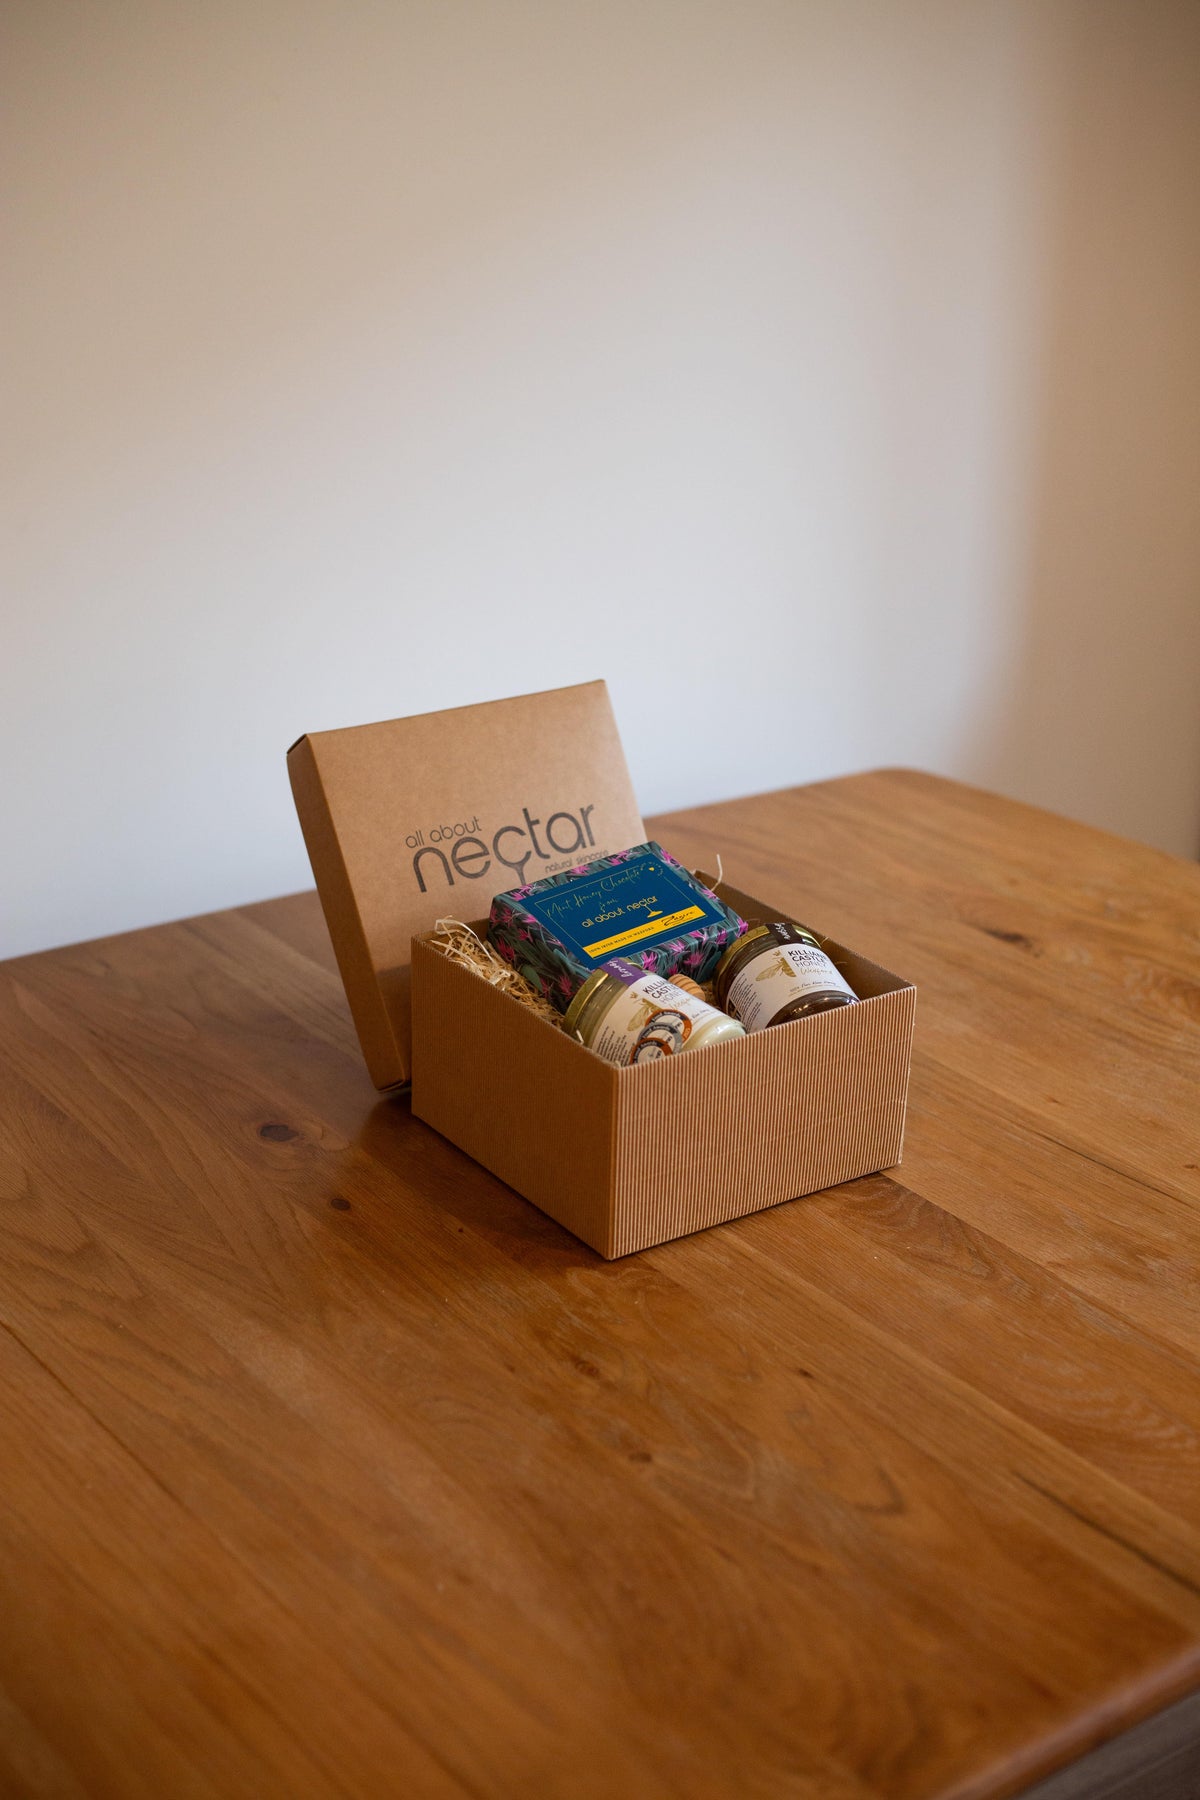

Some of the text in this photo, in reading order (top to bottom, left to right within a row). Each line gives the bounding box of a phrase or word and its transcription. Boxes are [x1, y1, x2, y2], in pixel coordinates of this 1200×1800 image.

[405, 816, 482, 849] all about
[413, 804, 594, 893] nectar
[581, 896, 658, 928] all about nectar
